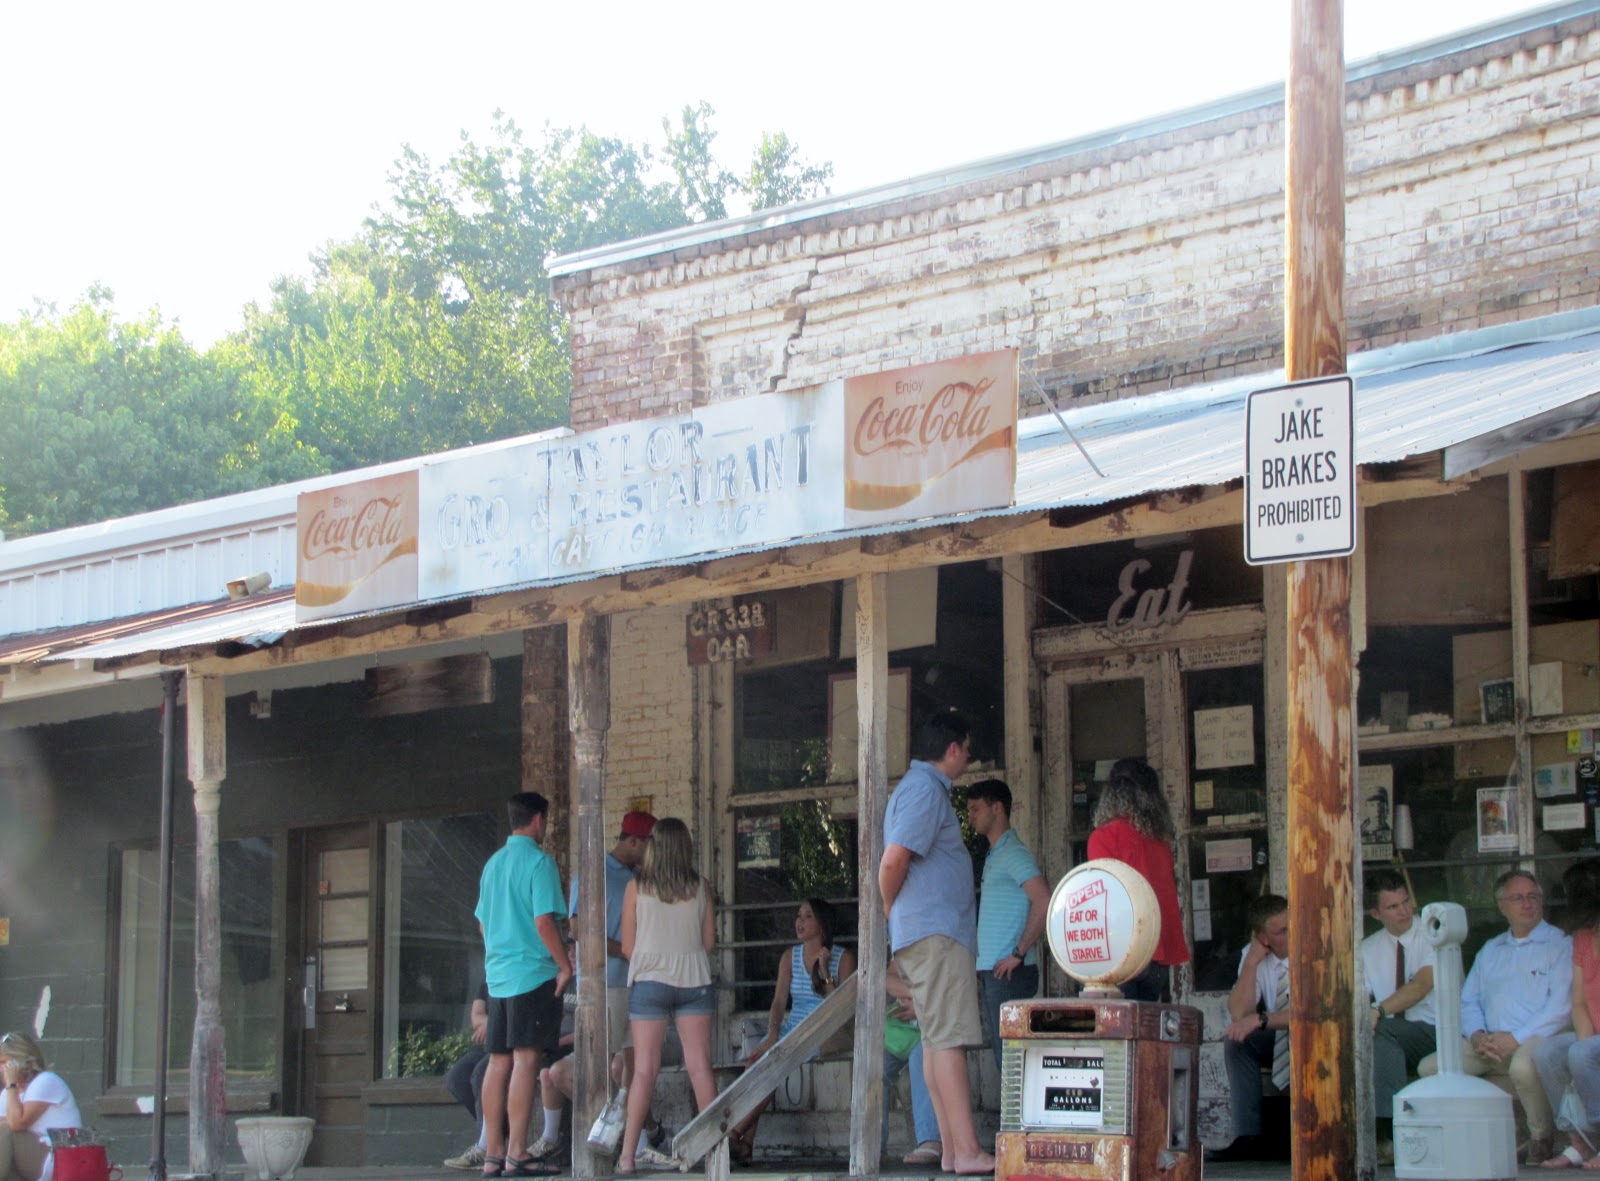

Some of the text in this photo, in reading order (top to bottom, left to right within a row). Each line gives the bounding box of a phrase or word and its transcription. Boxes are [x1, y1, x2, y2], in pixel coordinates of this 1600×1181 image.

[896, 379, 925, 395] Enjoy
[1274, 407, 1324, 444] JAKE
[536, 420, 704, 491] TAYLOR
[1262, 450, 1337, 490] BRAKES
[438, 423, 816, 551] GRO & RESTAURANT
[1258, 495, 1342, 528] PROHIBITED
[1106, 550, 1194, 633] Eat
[724, 601, 766, 631] 338
[1069, 881, 1104, 907] OPEN
[1069, 909, 1098, 923] EAT OR
[1067, 928, 1104, 942] WE BOTH
[1072, 946, 1103, 960] STARVE
[1043, 1058, 1104, 1068] TOTAL SALE
[1053, 1095, 1093, 1104] GALLONS
[1030, 1144, 1087, 1159] REGULAR
